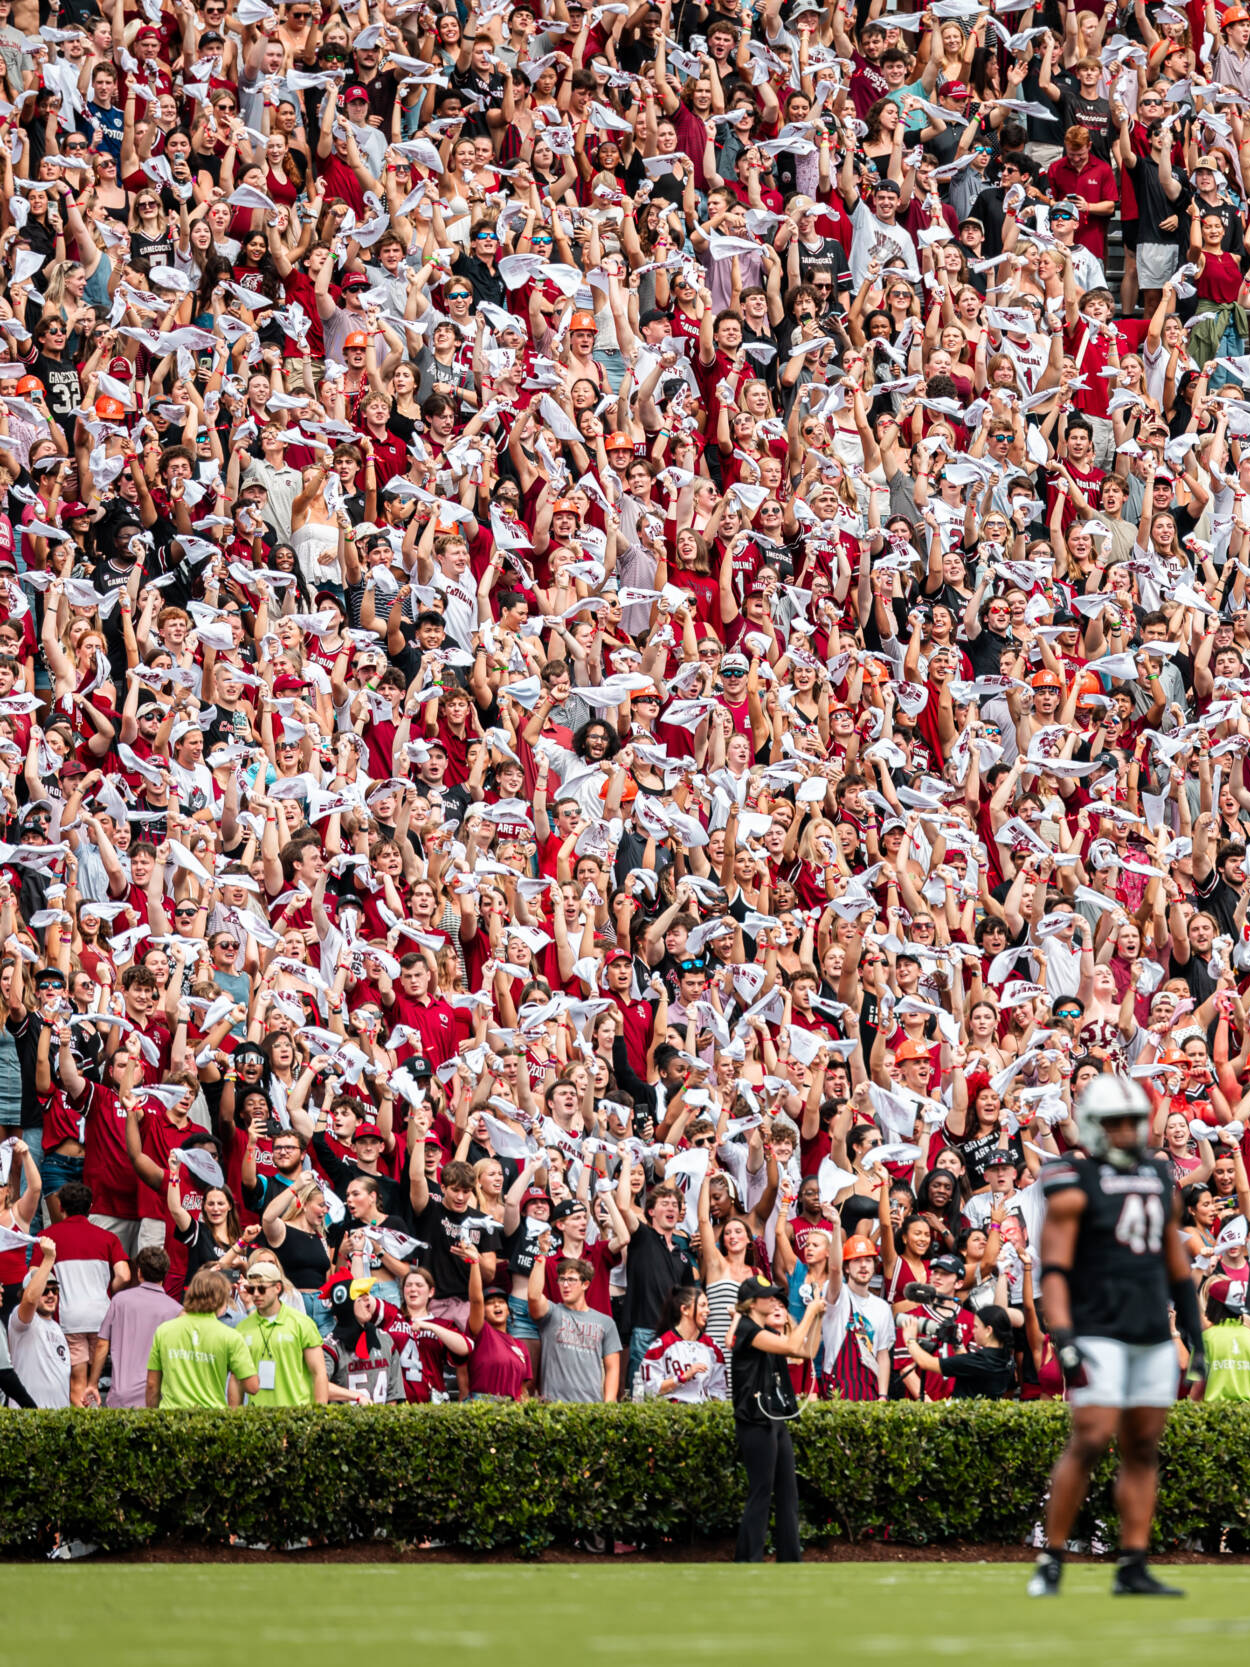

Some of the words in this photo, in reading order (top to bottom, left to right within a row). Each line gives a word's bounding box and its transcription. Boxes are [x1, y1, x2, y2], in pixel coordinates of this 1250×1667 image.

[497, 823, 511, 832] ARE
[1115, 1194, 1165, 1254] 41
[518, 1255, 531, 1267] THE
[348, 1358, 389, 1372] CAROLINA
[401, 1341, 422, 1379] 4
[348, 1372, 387, 1402] 54
